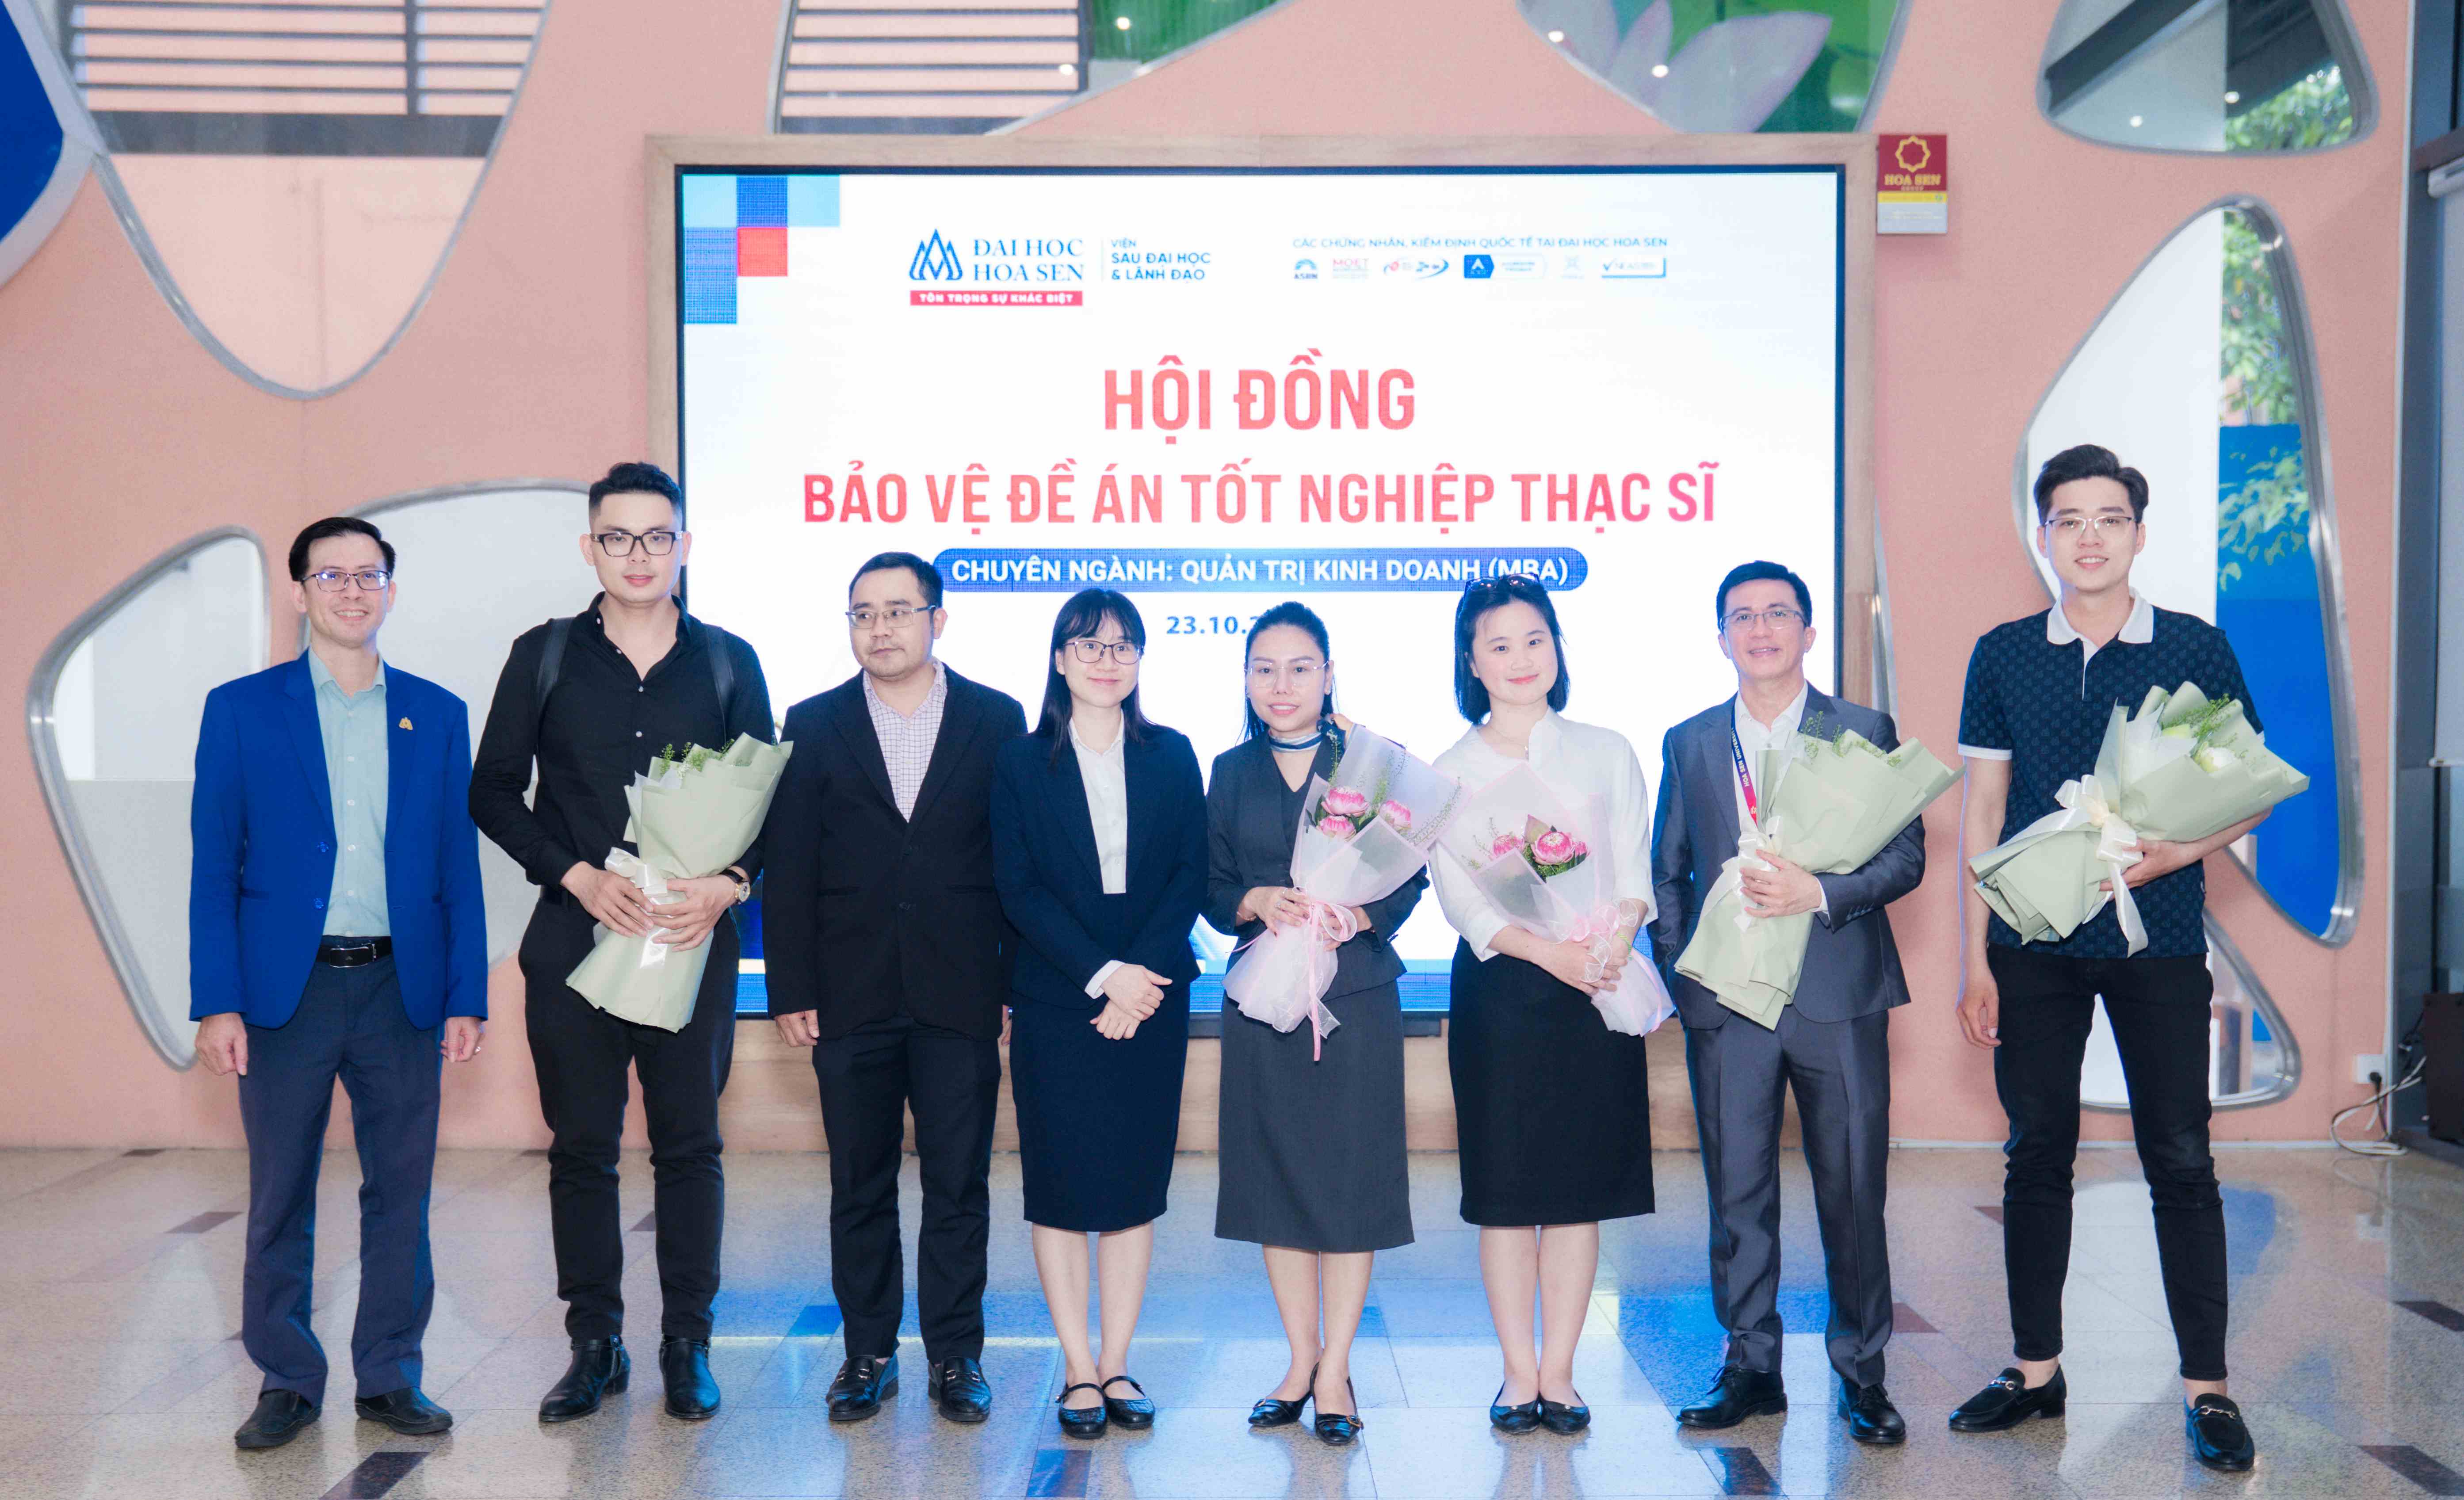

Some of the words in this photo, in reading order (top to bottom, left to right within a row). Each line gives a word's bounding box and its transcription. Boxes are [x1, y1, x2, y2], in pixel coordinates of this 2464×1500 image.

[1885, 174, 1912, 185] HOA
[1915, 174, 1941, 185] SEN
[1613, 237, 1641, 248] HOA
[1643, 237, 1669, 248] SEN
[1111, 252, 1142, 264] SAU
[1177, 252, 1210, 267] HỌC
[974, 263, 1029, 281] HOA
[1036, 263, 1083, 281] SEN
[1111, 269, 1121, 280] &
[919, 292, 944, 302] TÔN
[1011, 292, 1043, 303] KHÁC
[1105, 355, 1210, 444] HỘI
[1234, 348, 1415, 430] ĐỒNG
[804, 460, 907, 523] BẢO
[925, 463, 990, 534] VỆ
[1007, 458, 1077, 523] ĐỀ
[1093, 464, 1162, 523] ÁN
[1181, 458, 1281, 523] TỐT
[1301, 463, 1494, 534] NGHIỆP
[1511, 473, 1650, 534] THẠC
[1668, 462, 1719, 522] SĨ
[952, 554, 1060, 581] CHUYÊN
[1070, 555, 1172, 581] NGÀNH:
[1181, 554, 1256, 583] QUẢN
[1263, 560, 1305, 585] TRỊ
[1314, 560, 1377, 581] KINH
[1387, 559, 1480, 580] DOANH
[1488, 556, 1568, 586] (MBA)
[1738, 760, 1746, 773] SEN
